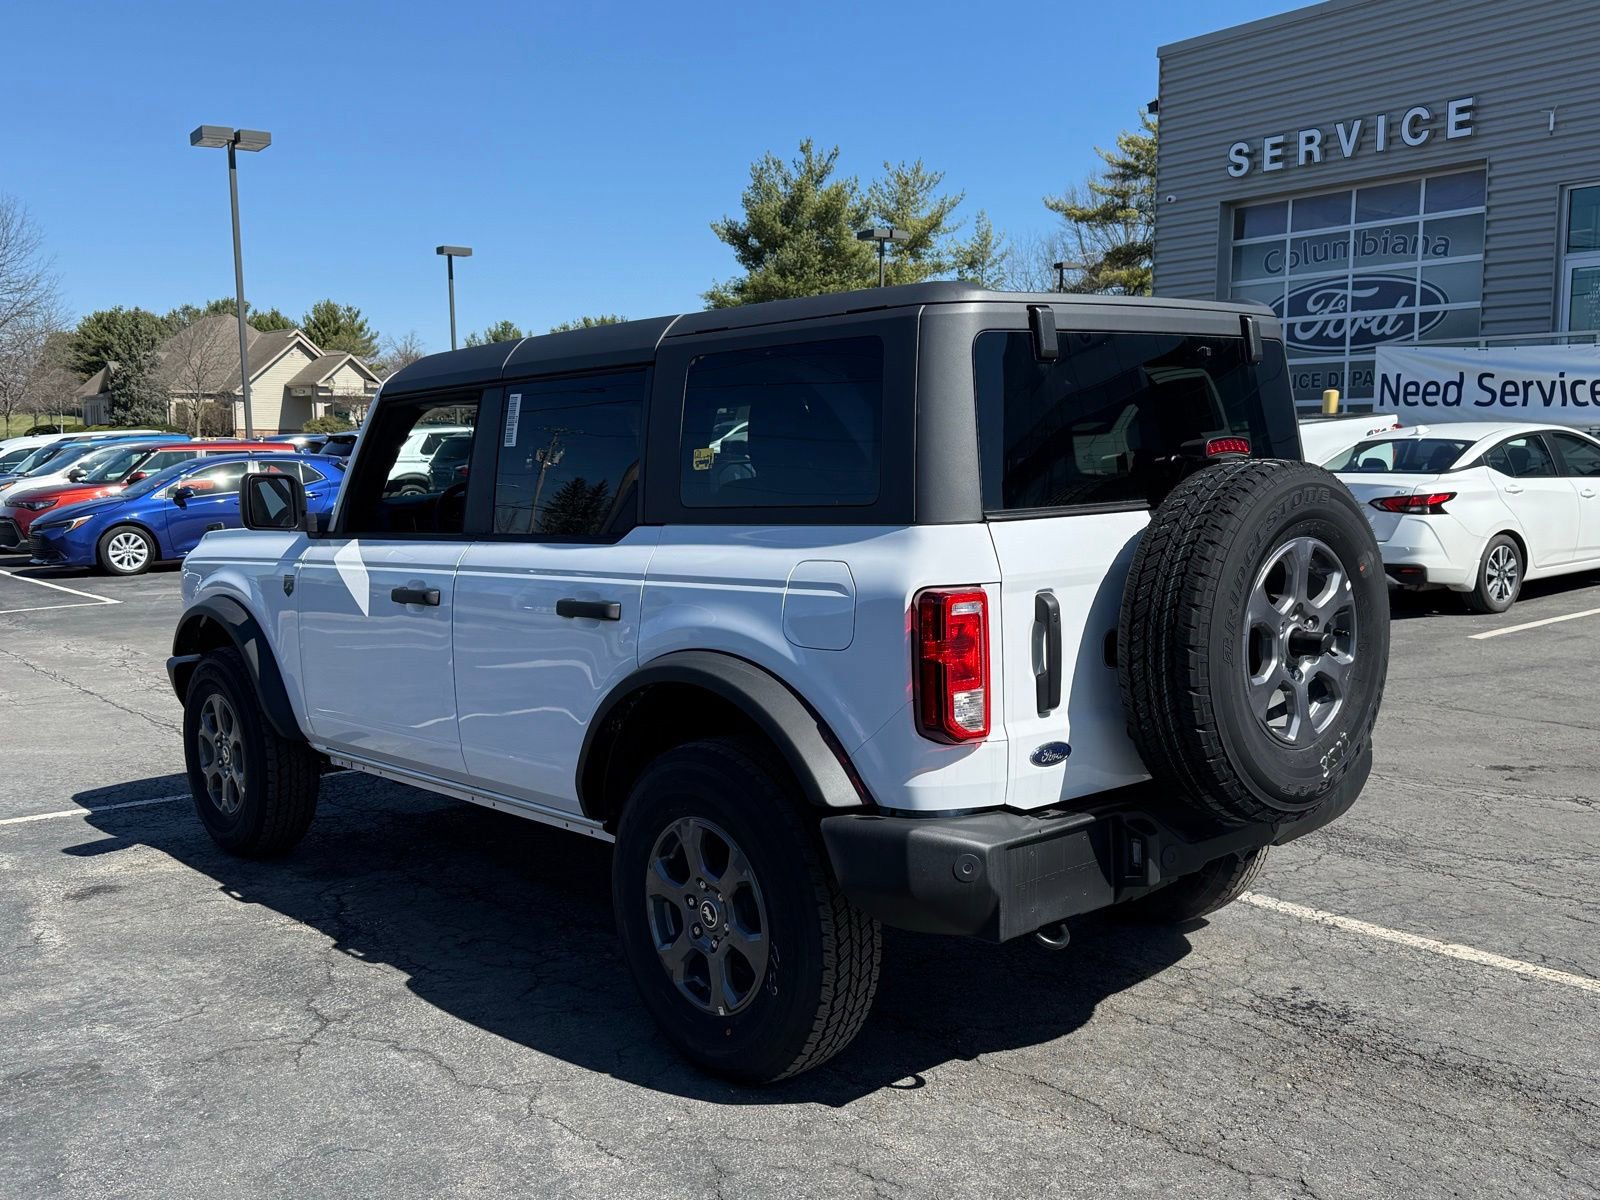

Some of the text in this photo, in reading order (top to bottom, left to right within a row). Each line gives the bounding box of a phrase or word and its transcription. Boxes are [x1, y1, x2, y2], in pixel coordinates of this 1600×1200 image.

[1227, 97, 1475, 178] SERVICE
[1263, 229, 1451, 275] Columbiana
[1294, 286, 1408, 341] Ford
[1379, 371, 1600, 408] Need Service
